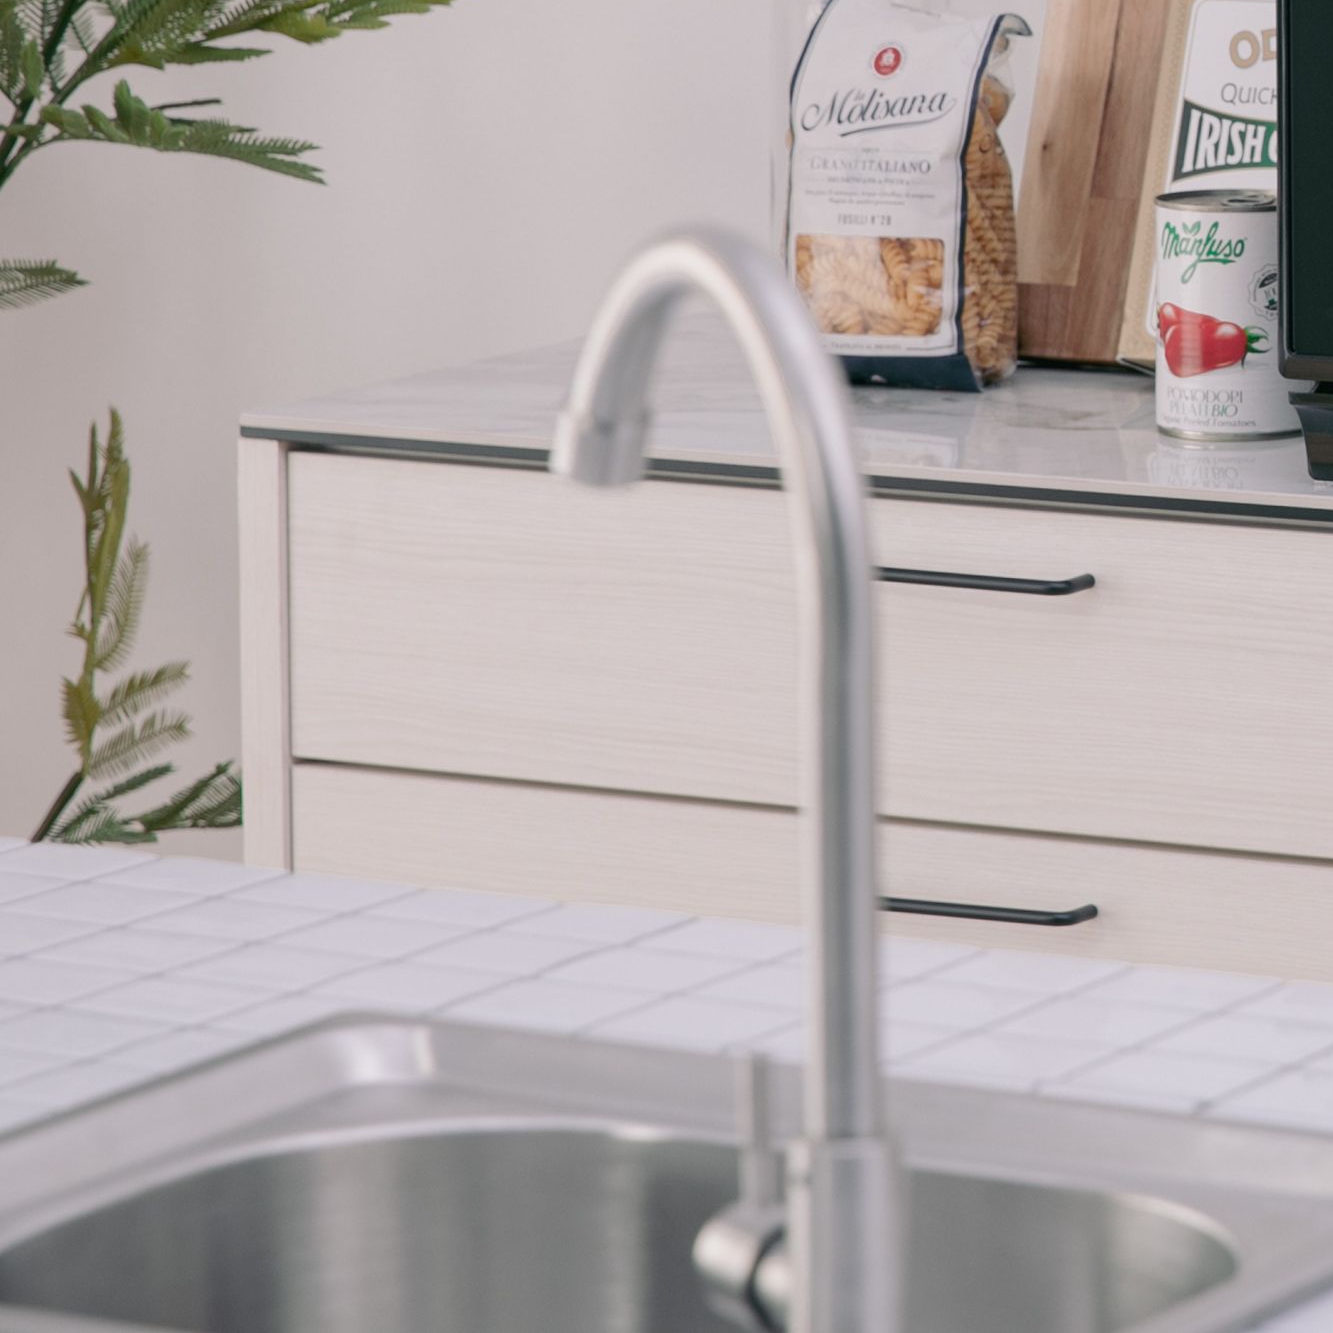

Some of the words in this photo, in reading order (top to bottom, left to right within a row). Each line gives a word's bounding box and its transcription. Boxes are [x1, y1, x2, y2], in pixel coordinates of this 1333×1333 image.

[801, 87, 958, 132] Molisana
[1182, 108, 1267, 173] IRISH
[1211, 404, 1239, 418] BIO
